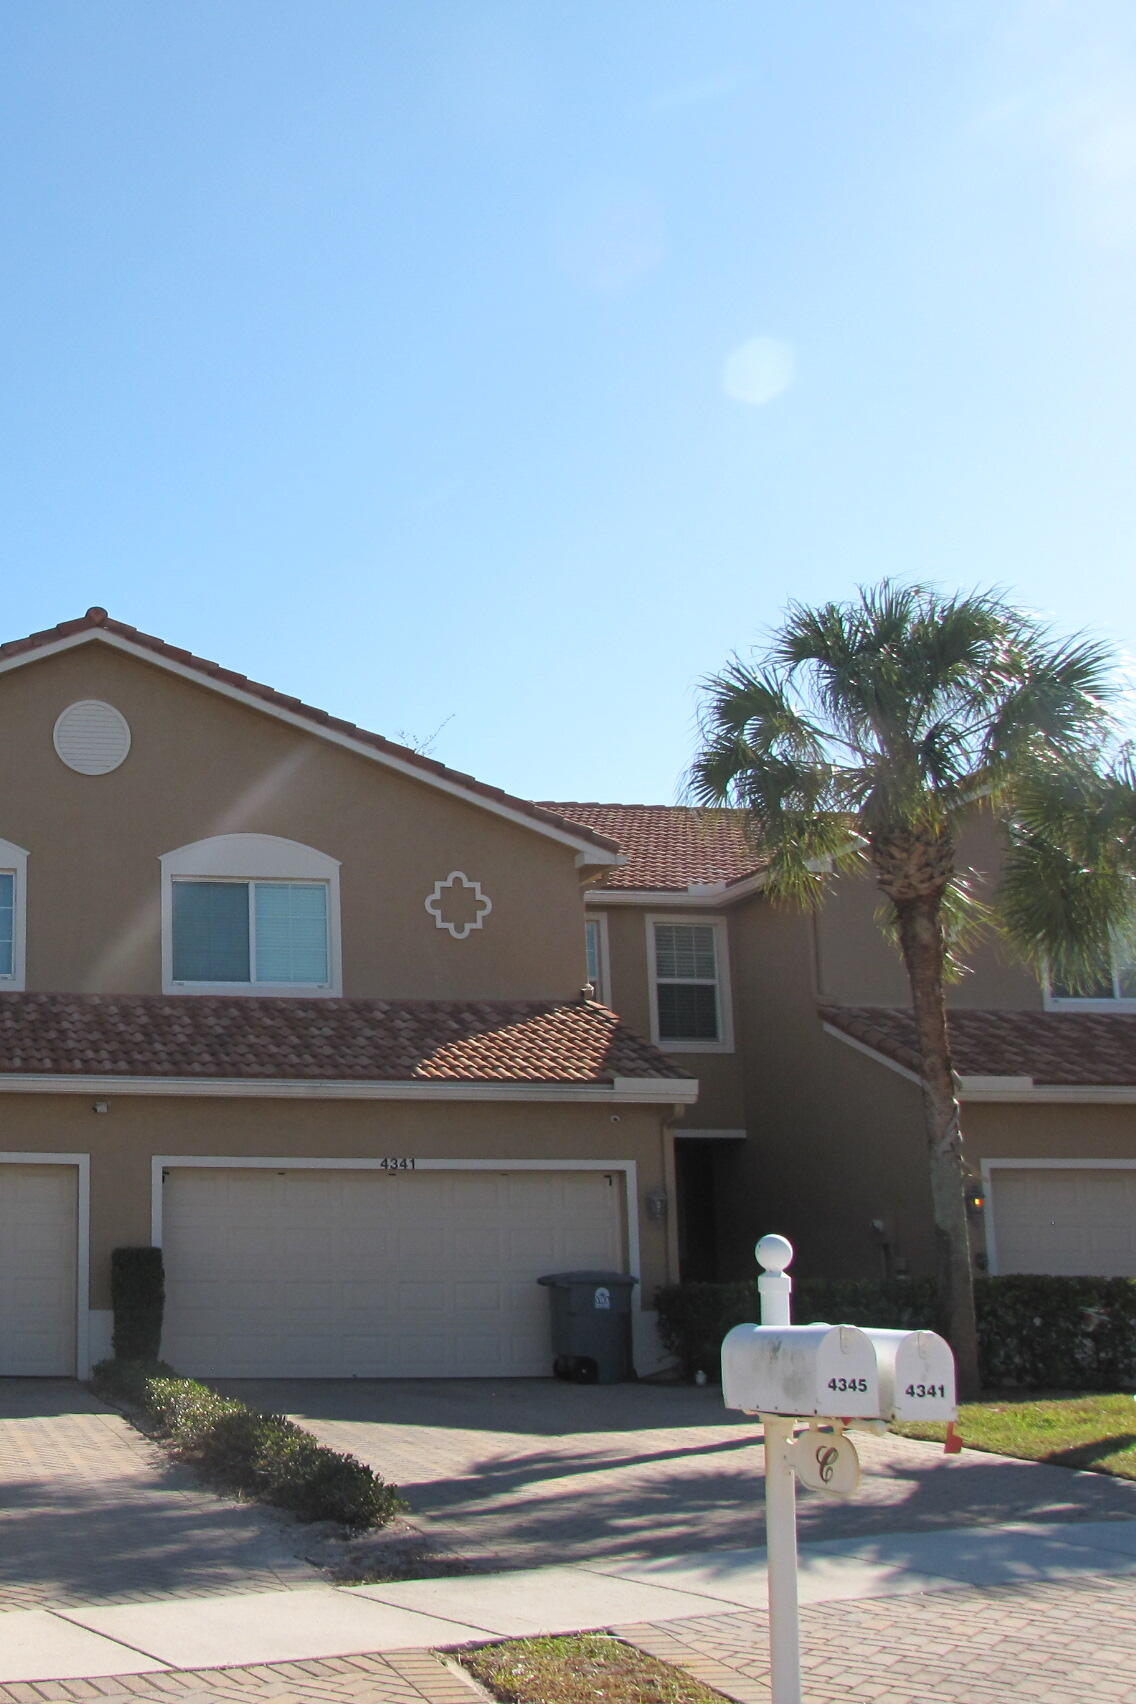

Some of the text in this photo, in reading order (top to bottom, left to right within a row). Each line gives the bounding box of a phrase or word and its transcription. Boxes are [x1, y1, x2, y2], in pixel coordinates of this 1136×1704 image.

[380, 1157, 415, 1169] 4341
[828, 1378, 867, 1392] 4345
[905, 1384, 944, 1398] 4341
